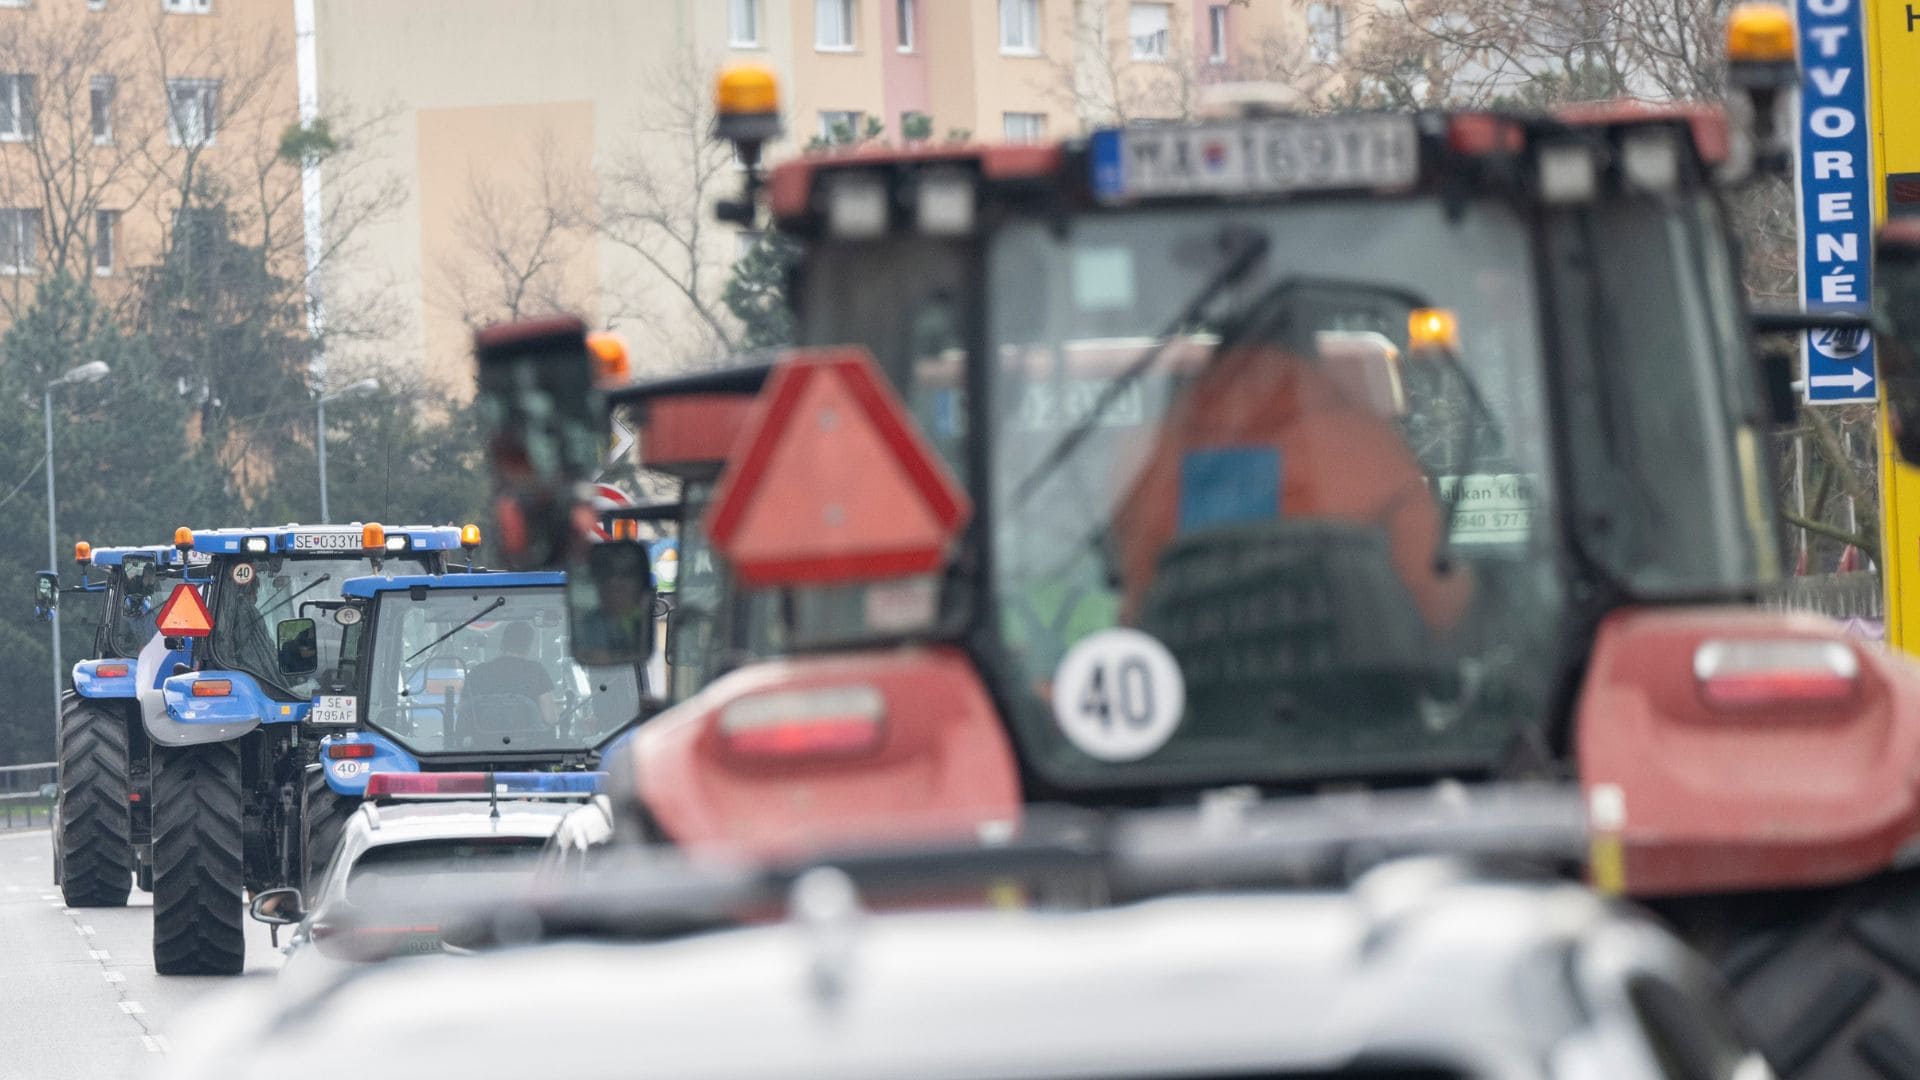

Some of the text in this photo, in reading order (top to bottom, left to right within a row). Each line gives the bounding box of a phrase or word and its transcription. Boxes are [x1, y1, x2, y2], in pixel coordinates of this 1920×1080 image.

[295, 534, 313, 549] SE
[236, 566, 250, 578] 40
[1079, 655, 1156, 733] 40
[327, 697, 342, 709] SE
[316, 710, 353, 721] 795AF
[337, 763, 357, 774] 40
